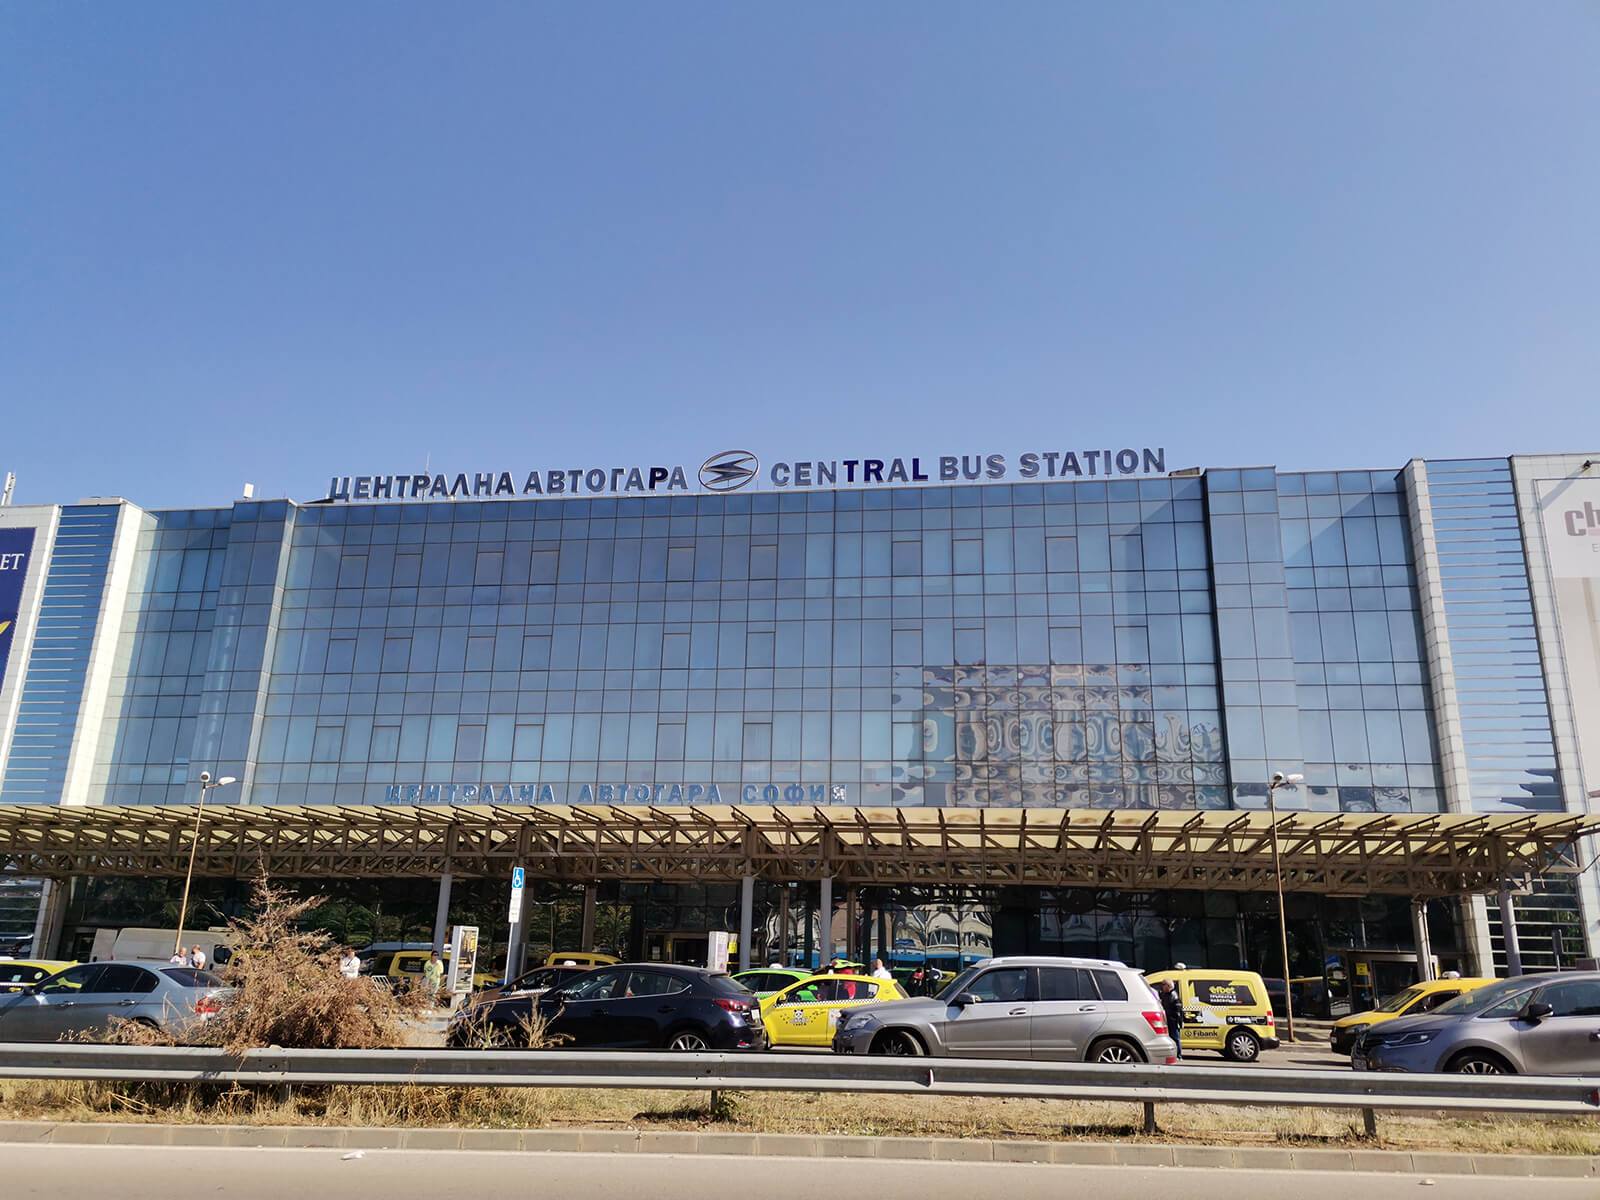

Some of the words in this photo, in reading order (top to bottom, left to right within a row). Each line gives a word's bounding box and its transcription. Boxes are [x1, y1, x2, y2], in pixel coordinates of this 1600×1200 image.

[329, 471, 515, 502] ЦЕНТРАЛНА
[522, 466, 689, 495] АВТОГАРА
[770, 457, 929, 487] CENTRAL
[939, 454, 1007, 481] BUS
[1018, 447, 1166, 477] STATION
[384, 783, 556, 804] ЦЕНТРАЛНА
[577, 783, 722, 803] АВТОГАРА
